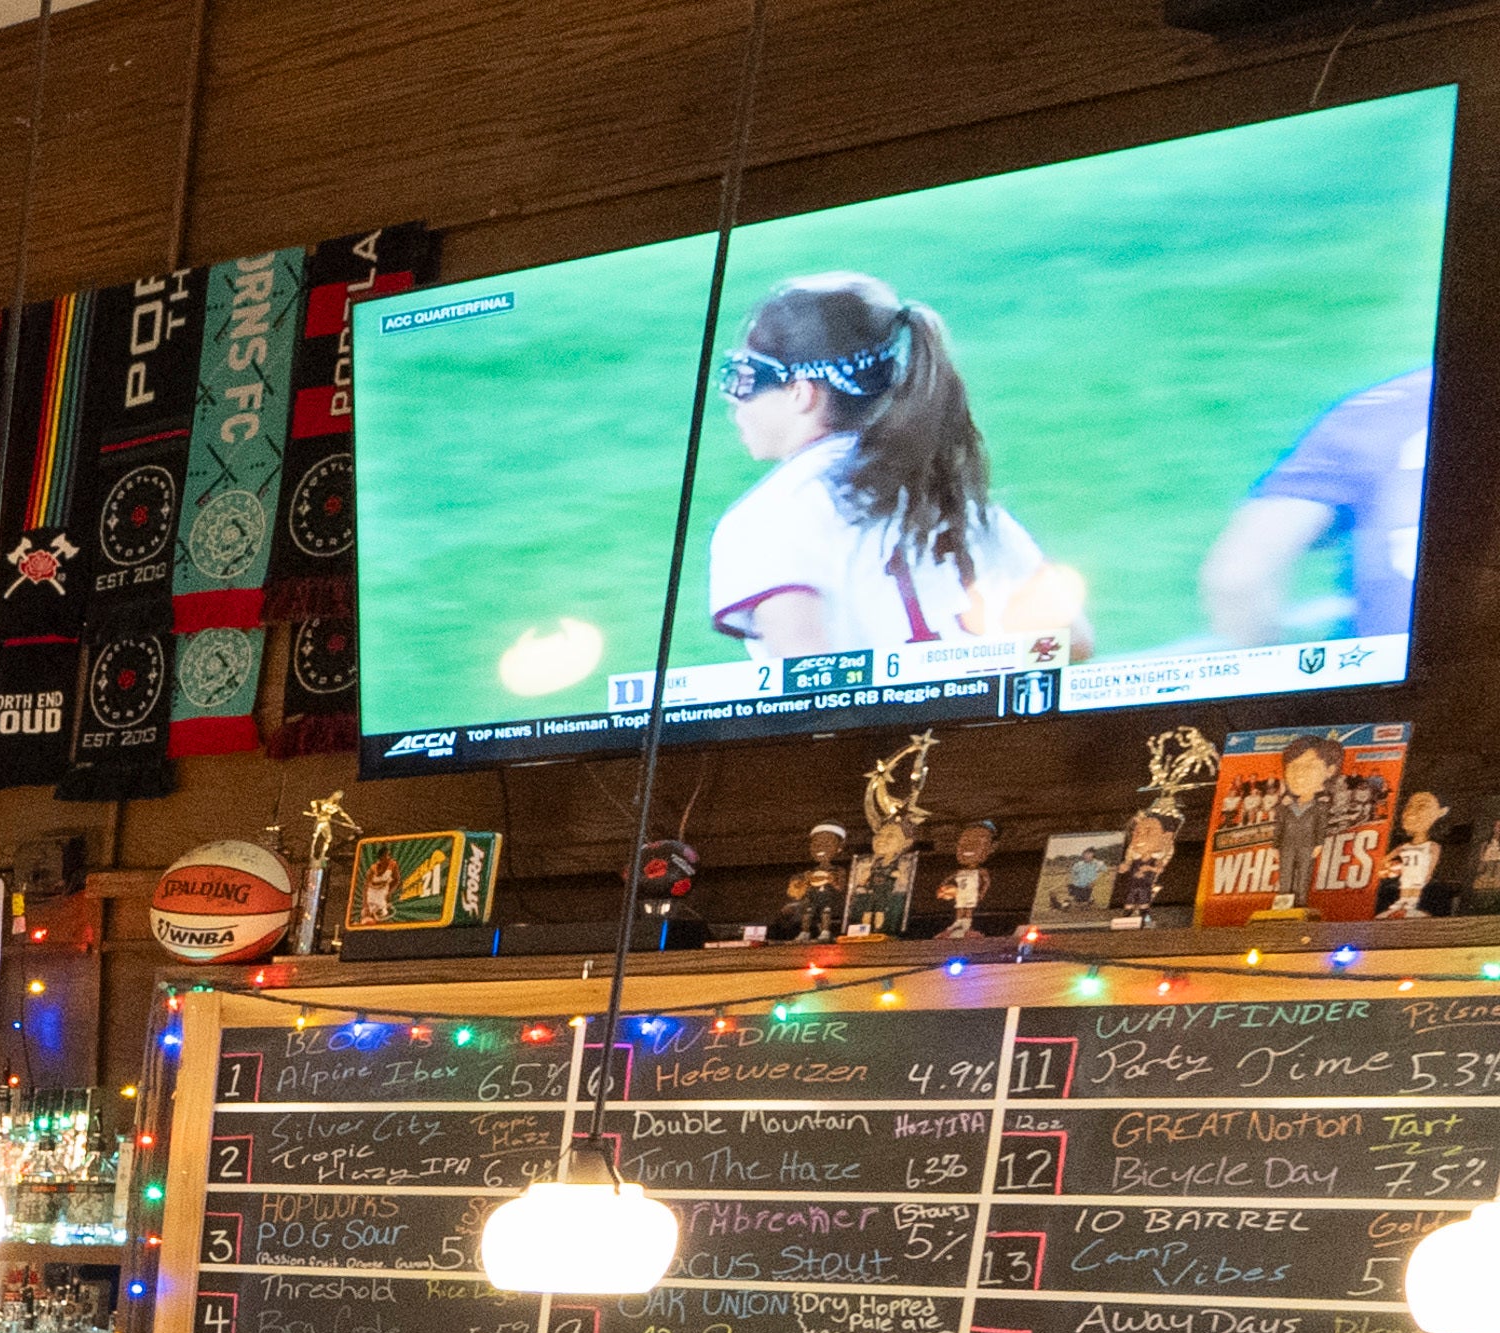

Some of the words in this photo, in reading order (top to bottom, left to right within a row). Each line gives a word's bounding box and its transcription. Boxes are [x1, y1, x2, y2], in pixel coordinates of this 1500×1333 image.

[385, 316, 412, 330] ACC
[414, 295, 511, 324] QUARTERFINAL
[220, 384, 264, 443] FC
[838, 653, 866, 669] 2nd
[886, 652, 901, 679] 6
[926, 645, 969, 663] BOSTON
[971, 641, 1017, 658] COLLEGE
[757, 666, 772, 691] 2
[796, 669, 833, 688] 8:16
[845, 669, 864, 685] 31
[1070, 676, 1120, 690] GOLDEN
[1125, 669, 1181, 685] KNIGHTS
[1199, 663, 1240, 678] STARS
[37, 691, 64, 708] END
[467, 728, 493, 742] TOP
[495, 723, 532, 740] NEWS
[543, 714, 608, 735] Heisman
[665, 702, 734, 724] returned
[735, 702, 753, 718] to
[756, 694, 812, 716] former
[815, 688, 851, 709] USC
[854, 686, 879, 705] RB
[882, 680, 942, 706] Reggie
[943, 678, 989, 698] Bush
[1212, 829, 1380, 895] WHEIES
[161, 879, 250, 905] SPALDING
[169, 927, 235, 946] WNBA
[1095, 1001, 1372, 1039] WAYFINDER
[651, 1020, 850, 1056] WIDMER
[654, 1057, 870, 1093] Hefeweizen
[906, 1060, 997, 1095] 4.9%
[1009, 1047, 1058, 1095] 11
[1090, 1040, 1216, 1084] Party
[1236, 1036, 1396, 1088] Time
[276, 1062, 372, 1093] Alpine
[381, 1060, 459, 1088] Ibex
[477, 1060, 572, 1100] 6.5%
[269, 1112, 361, 1153] Silver
[372, 1113, 446, 1145] City
[631, 1108, 728, 1140] Double
[739, 1108, 873, 1136] Mountain
[1112, 1110, 1245, 1149] GREAT
[1248, 1112, 1366, 1142] Notion
[1380, 1112, 1464, 1138] Tart
[219, 1146, 240, 1179] 2
[420, 1156, 472, 1178] IPA
[621, 1147, 695, 1183] Turn
[701, 1146, 773, 1183] The
[779, 1155, 862, 1184] Haze
[997, 1149, 1054, 1192] 12
[1111, 1156, 1255, 1195] Bicycle
[1263, 1156, 1340, 1195] Day
[1373, 1156, 1487, 1199] 7.5%
[341, 1221, 410, 1250] Sour
[1073, 1208, 1126, 1235] 10
[1143, 1208, 1312, 1234] BARREL
[207, 1229, 235, 1264] 3
[777, 1245, 894, 1277] Stout
[1070, 1239, 1190, 1273] Camp
[1152, 1255, 1294, 1289] Vibes
[981, 1250, 1034, 1288] 13
[260, 1273, 398, 1303] Threshold
[701, 1290, 791, 1320] UNION
[801, 1291, 850, 1324] Dry
[859, 1293, 936, 1317] Hopped
